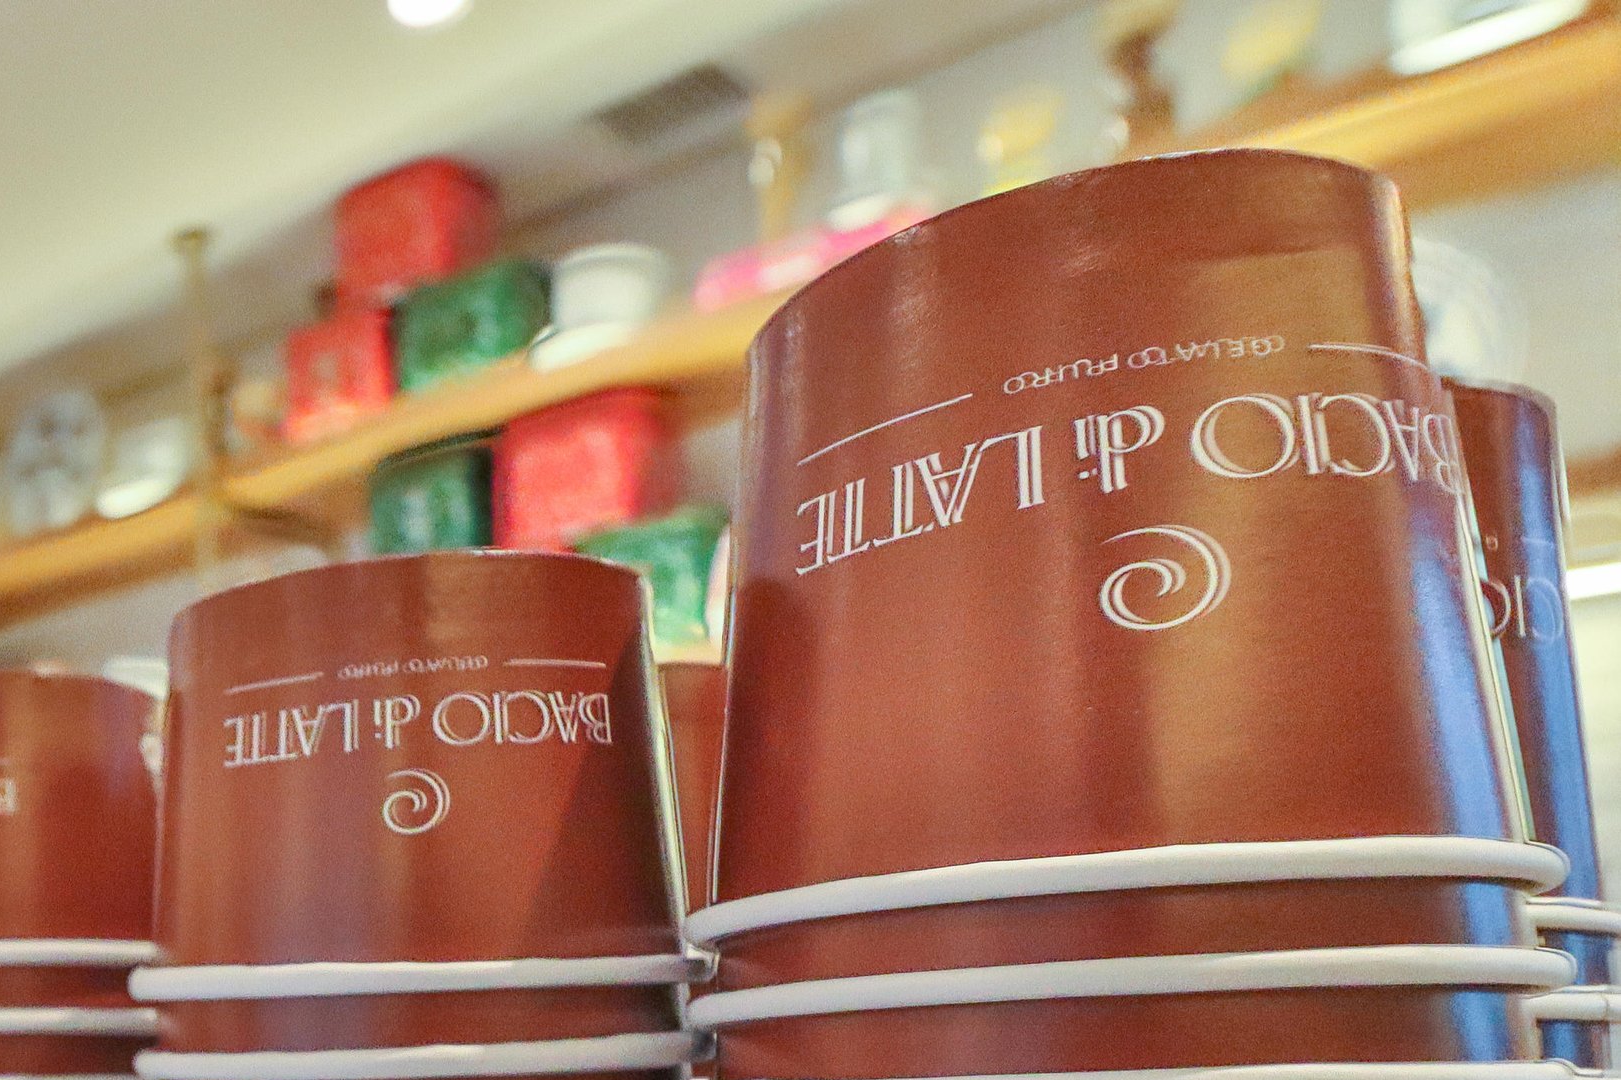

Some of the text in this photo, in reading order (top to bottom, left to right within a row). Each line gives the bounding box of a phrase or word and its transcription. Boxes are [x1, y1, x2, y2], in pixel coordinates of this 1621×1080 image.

[1003, 335, 1285, 395] GELATO PURO
[795, 391, 1469, 575] BACIO di LATTE
[223, 691, 612, 768] BACIO di LATTE
